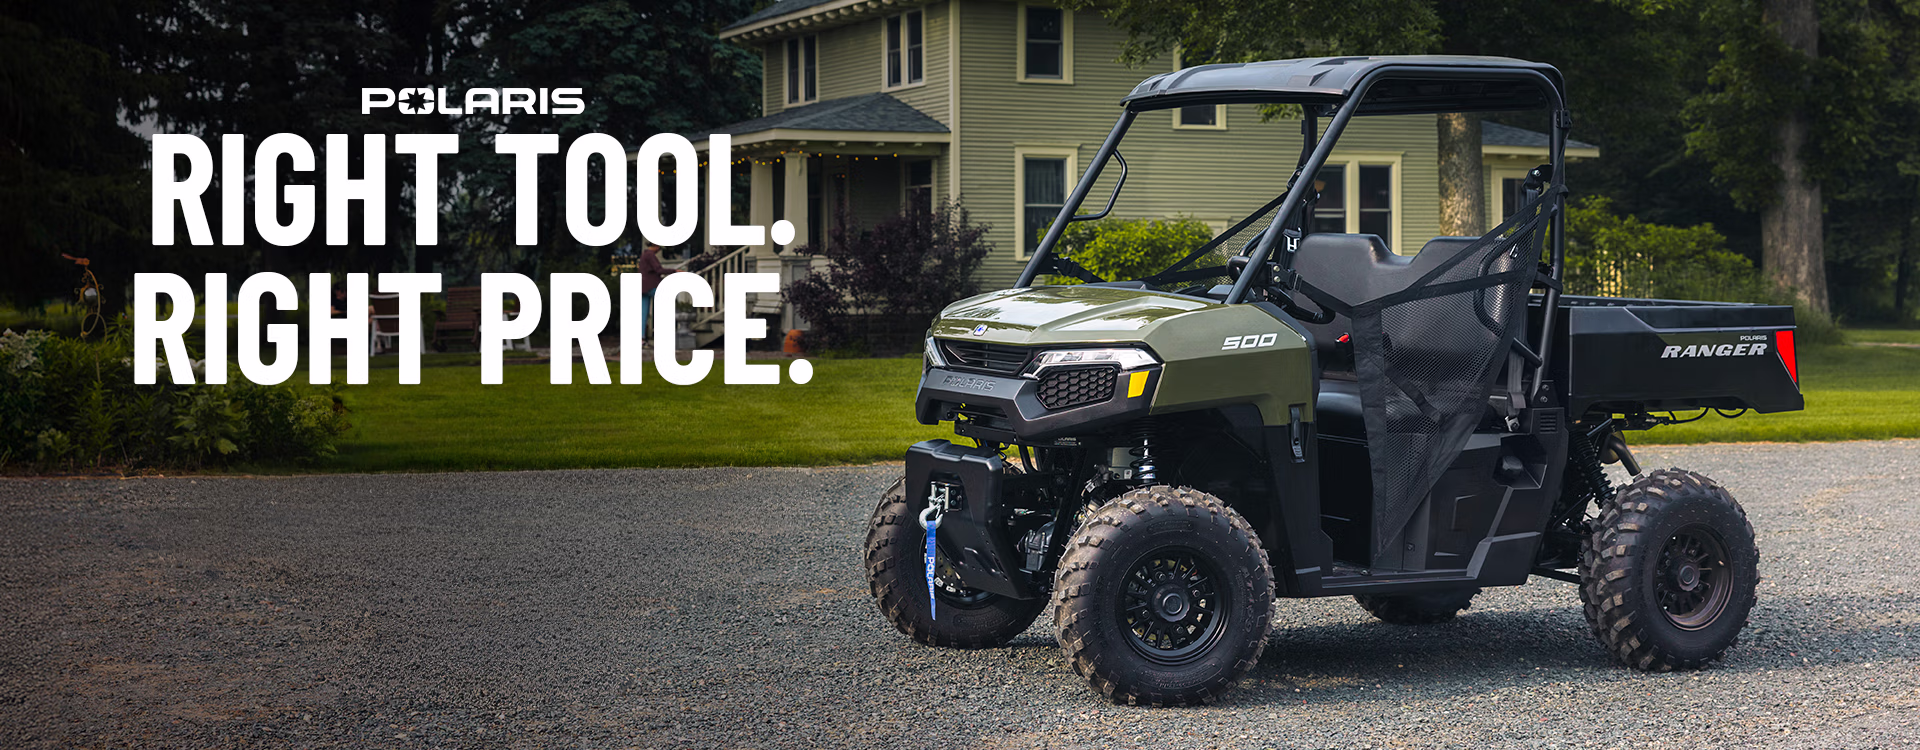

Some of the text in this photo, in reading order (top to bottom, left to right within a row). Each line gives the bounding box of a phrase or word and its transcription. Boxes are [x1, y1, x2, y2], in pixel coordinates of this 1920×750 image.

[1221, 333, 1278, 350] 500
[1661, 343, 1768, 358] RANGER
[943, 375, 997, 391] POLARIS
